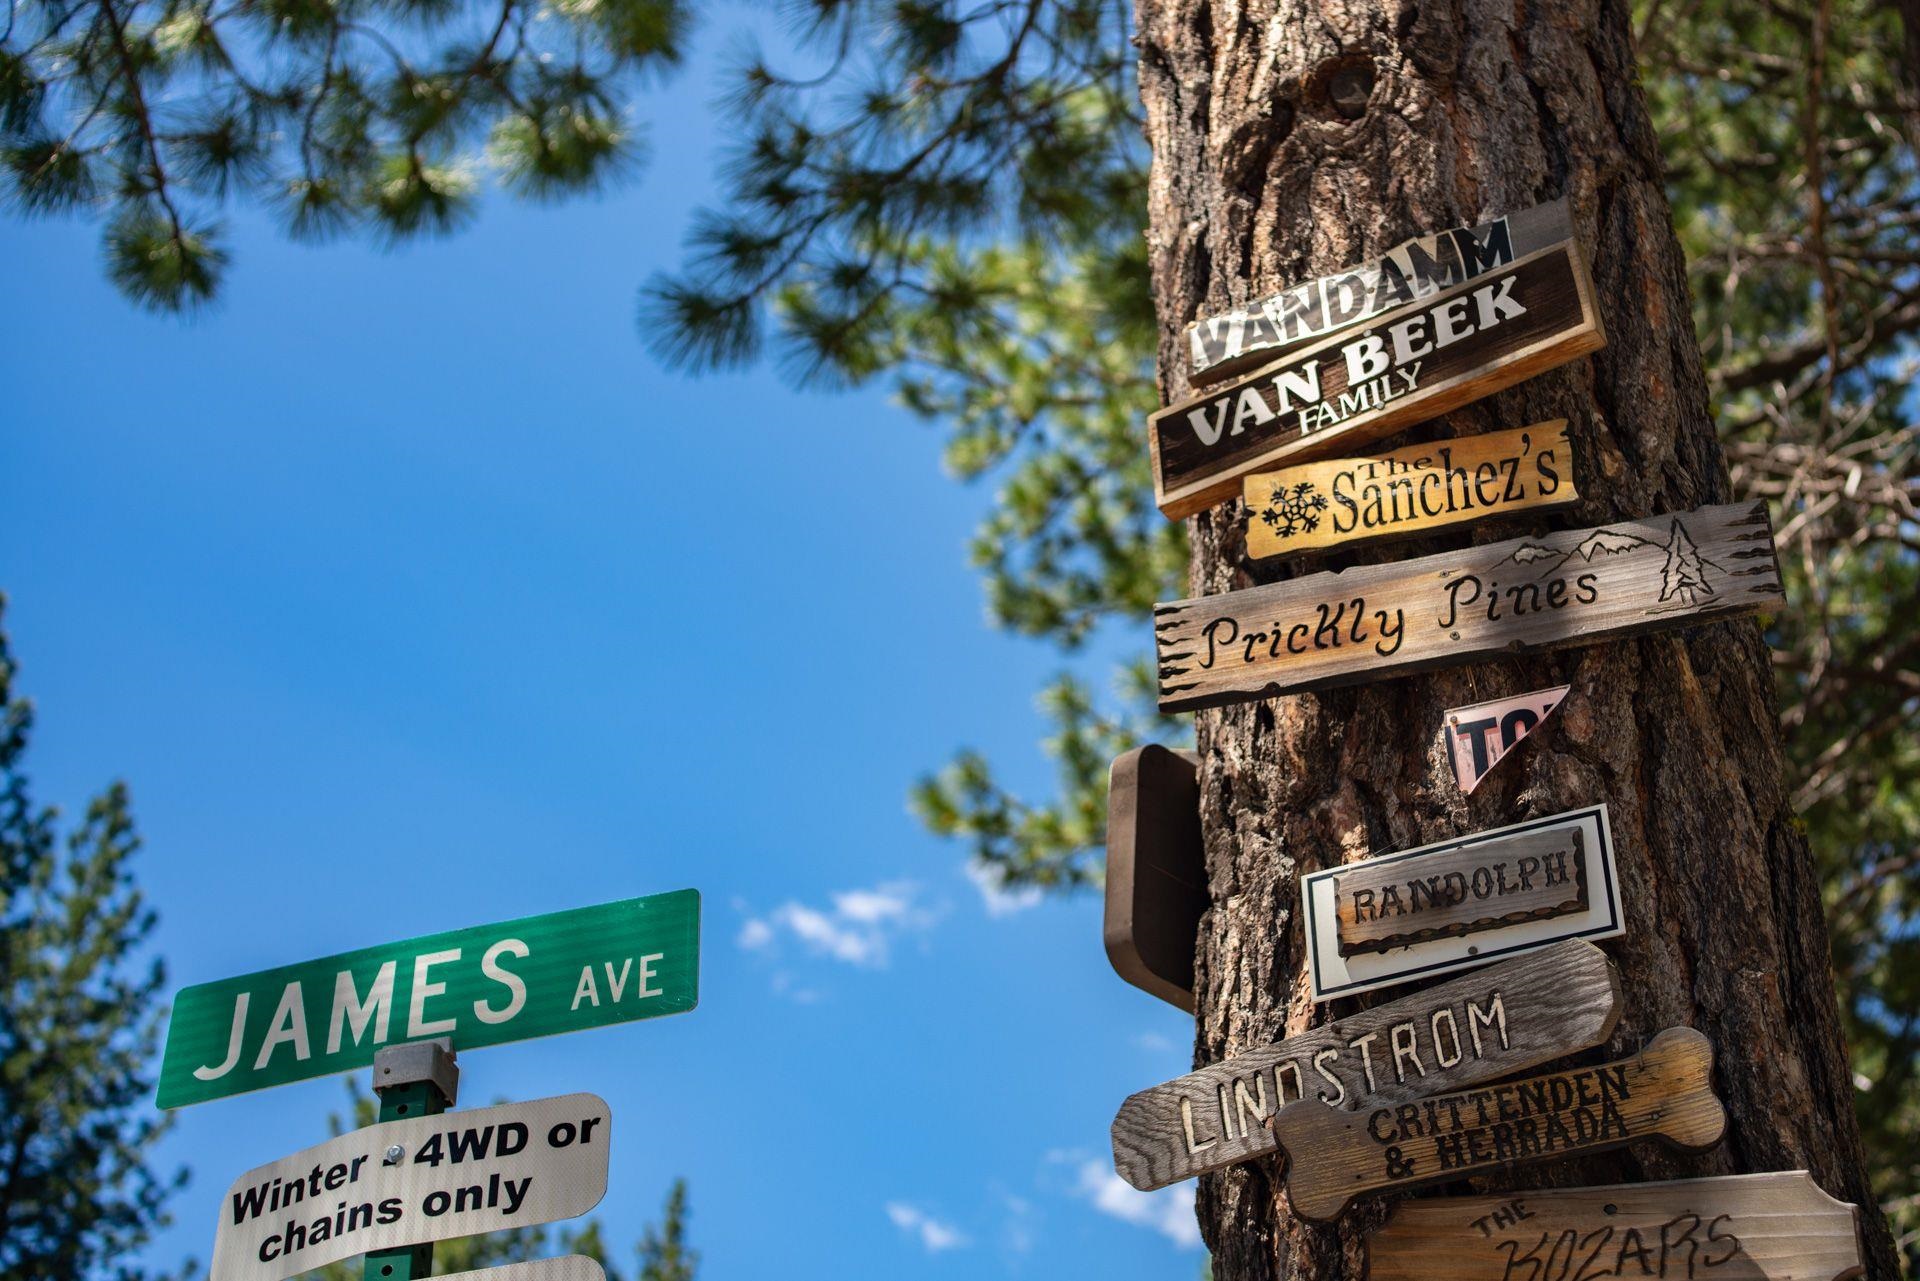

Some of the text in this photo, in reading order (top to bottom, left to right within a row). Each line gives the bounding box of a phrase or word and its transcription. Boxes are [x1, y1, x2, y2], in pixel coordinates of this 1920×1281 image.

[1196, 217, 1511, 366] VANDAMM
[1187, 275, 1527, 447] VAN BEEK
[1299, 361, 1422, 437] FAMILY
[1332, 433, 1560, 534] Sanchez's
[1358, 456, 1433, 481] The
[1438, 572, 1599, 629] Pines
[1352, 850, 1570, 925] RANDOLPH
[193, 938, 664, 1081] JAMES AVE
[1367, 1064, 1631, 1146] CRITTENDEN
[1384, 1101, 1630, 1179] & HERRADA
[232, 1153, 368, 1226] Winter
[414, 1121, 529, 1168] 4WD
[547, 1116, 601, 1149] or
[258, 1173, 533, 1263] chains only
[1470, 1200, 1536, 1239] THE
